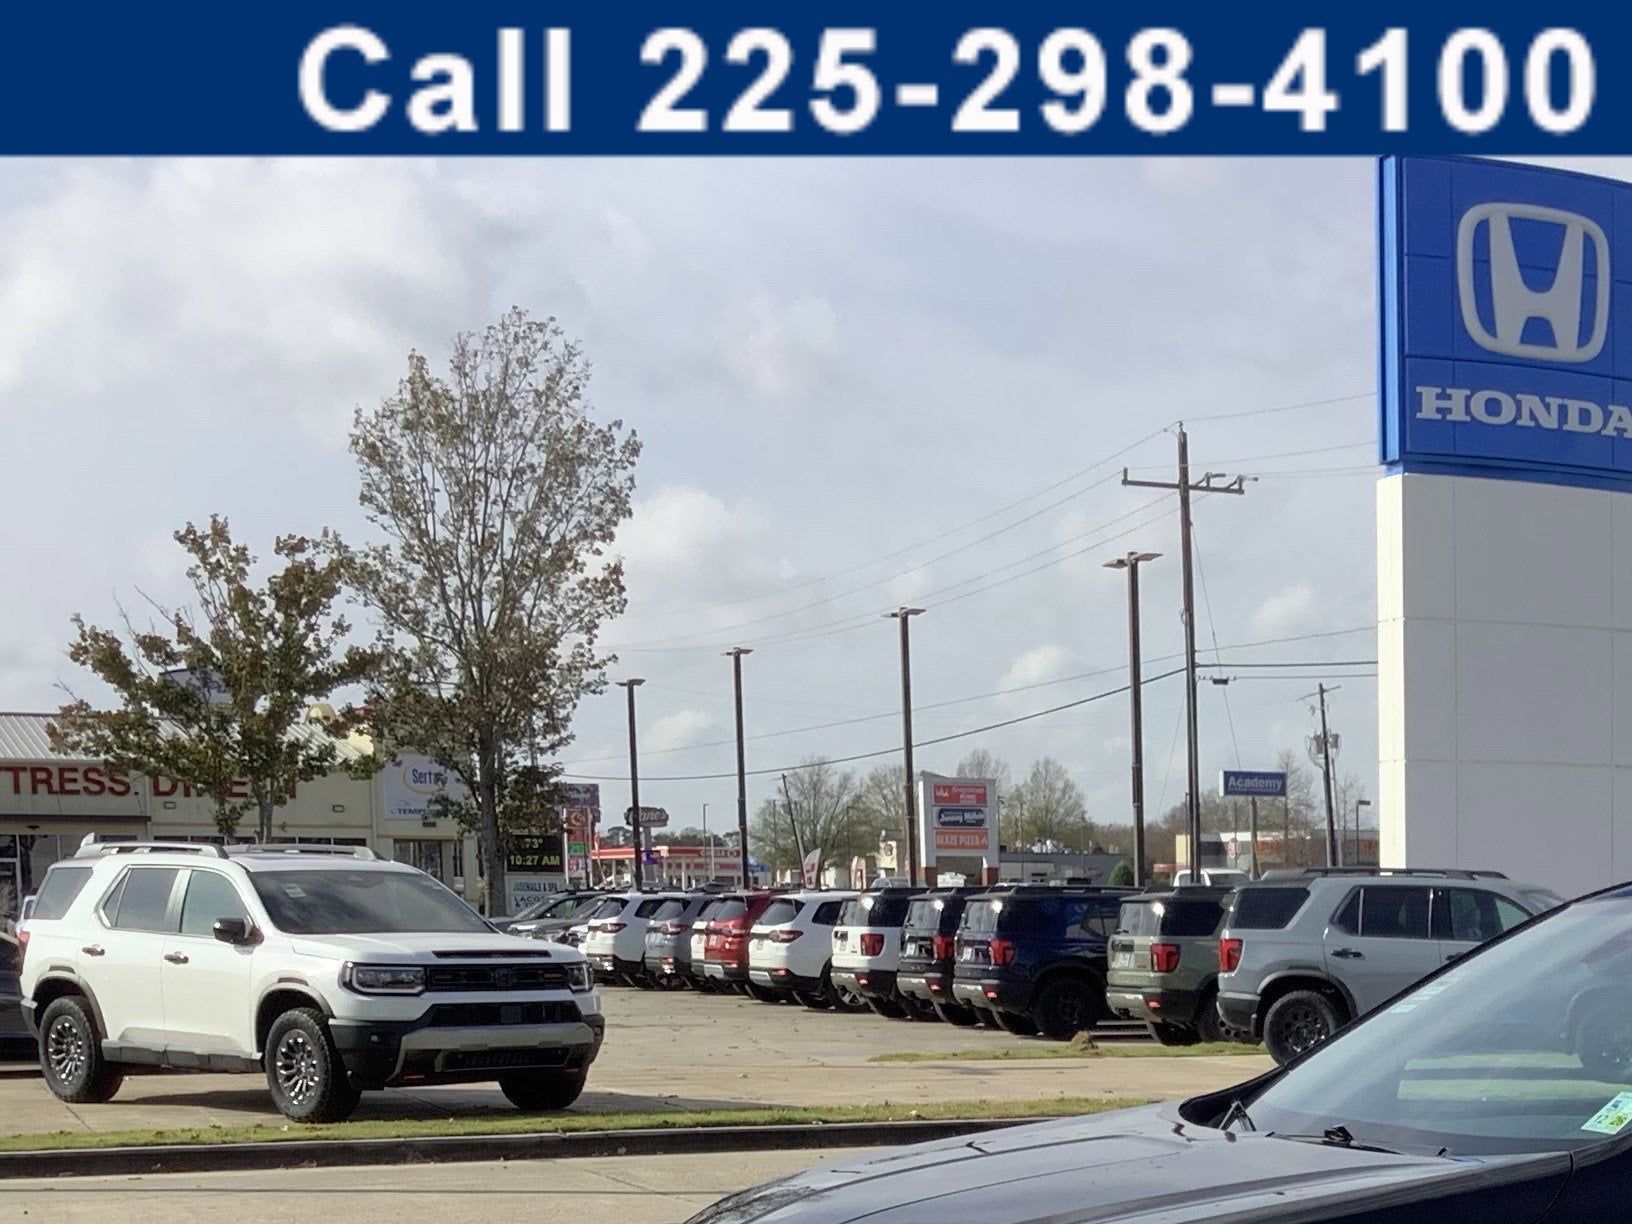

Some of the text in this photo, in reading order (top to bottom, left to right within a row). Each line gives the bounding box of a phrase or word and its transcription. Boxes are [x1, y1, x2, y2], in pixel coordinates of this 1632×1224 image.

[0, 766, 131, 796] TRESS
[1228, 775, 1283, 791] Academy
[509, 855, 538, 866] 10:27
[542, 855, 560, 866] AM
